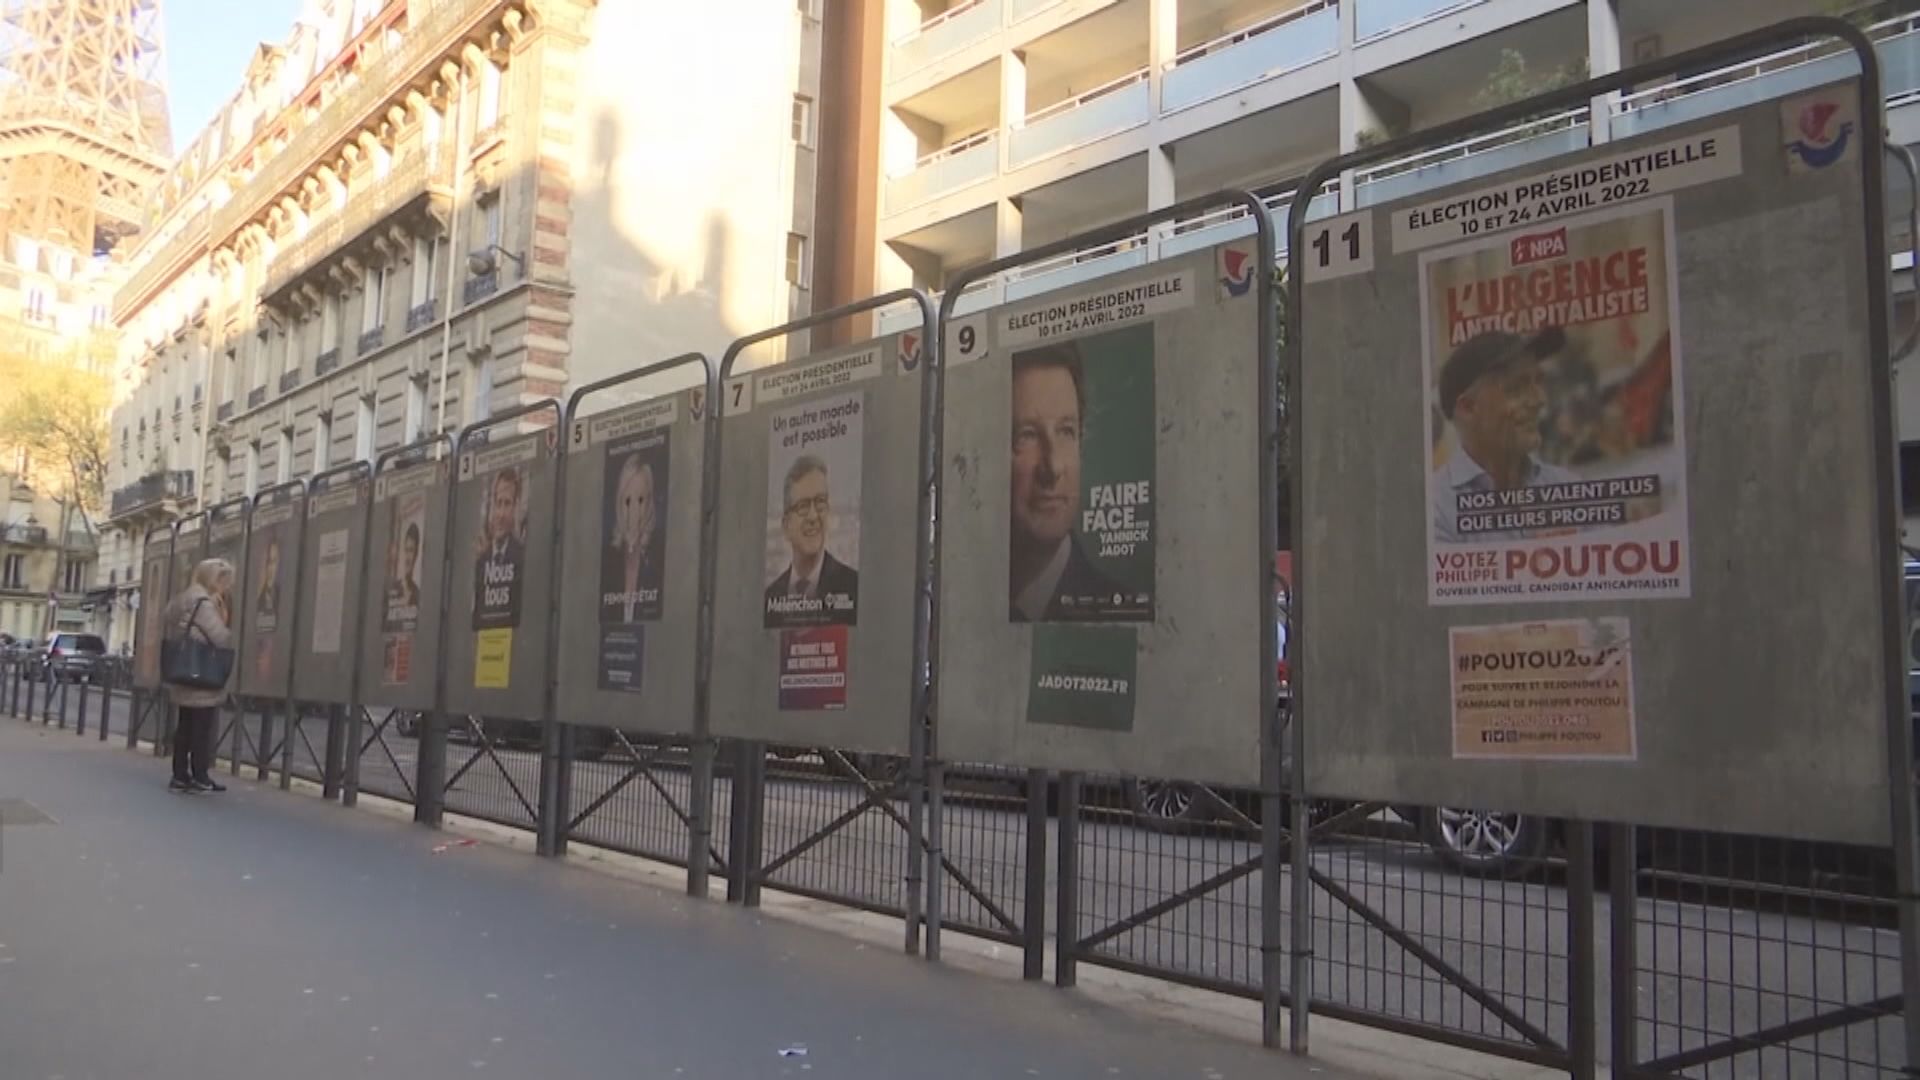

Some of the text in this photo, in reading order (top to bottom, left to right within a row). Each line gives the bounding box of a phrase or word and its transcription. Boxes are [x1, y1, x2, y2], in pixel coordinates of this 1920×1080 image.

[1408, 139, 1717, 230] ÉLECTION PRÉSIDENTIELLE
[1461, 177, 1650, 236] 10 ET 24 AVRIL 2022
[1312, 222, 1360, 267] 11
[1530, 235, 1565, 258] NPA
[1448, 247, 1648, 318] L'URGENCE
[1008, 278, 1182, 331] ÉLECTION PRÉSIDENTIELLE
[1451, 287, 1647, 345] ANTICAPITALISTE
[1038, 303, 1145, 338] 10 ET 24 AVRIL 2022
[958, 325, 976, 354] 9
[733, 383, 744, 407] 7
[772, 400, 861, 432] Un autre monde
[574, 424, 582, 444] 5
[783, 420, 848, 448] est possible
[463, 456, 470, 473] 3
[1090, 481, 1150, 508] FAIRE
[1459, 477, 1655, 509] NOS VIES VALENT PLUS
[1459, 504, 1621, 532] QUE LEURS PROFITS
[1099, 543, 1135, 557] JADOT
[1100, 530, 1149, 545] YANNICK
[1436, 551, 1499, 569] VOTEZ
[1505, 540, 1680, 580] POUTOU
[484, 561, 514, 586] Nous
[1436, 569, 1499, 584] PHILIPPE
[484, 586, 510, 607] tous
[1436, 586, 1478, 598] OUVRIER
[1529, 581, 1584, 593] CANDIDAT
[1586, 578, 1680, 590] ANTICAPITALISTE
[767, 594, 823, 613] Mélenchon
[1037, 674, 1129, 694] JADOT2022.FR
[1461, 683, 1489, 693] POUR
[1492, 682, 1527, 692] SUIVRE
[1530, 682, 1540, 690] ET
[1606, 679, 1620, 688] LA
[1457, 697, 1621, 710] CAMPAGNE DE PHILIPPE POUTOU
